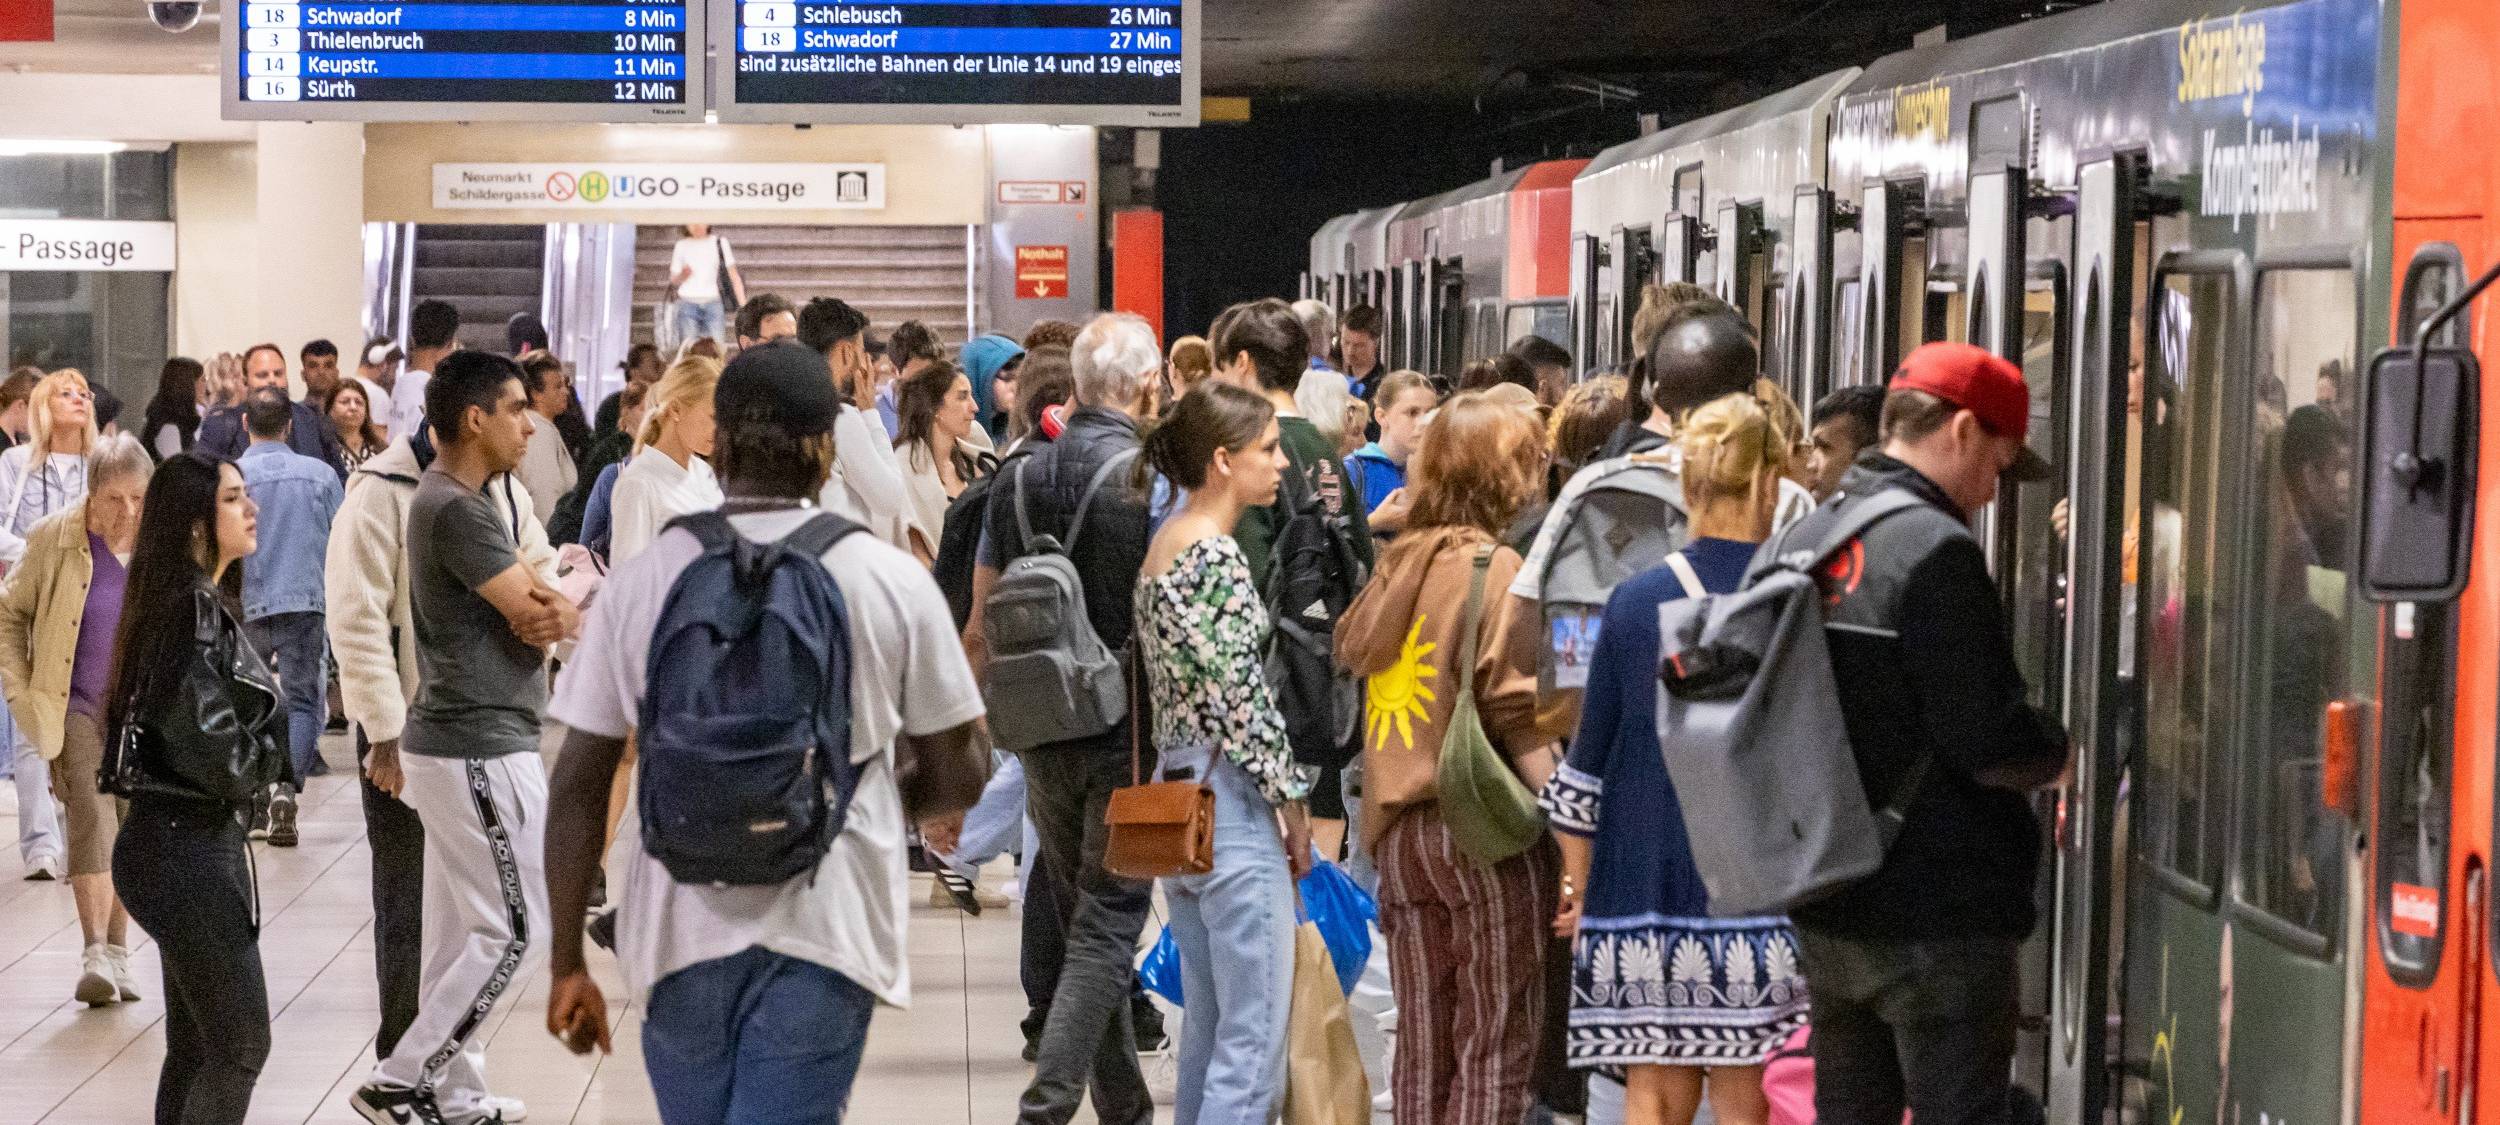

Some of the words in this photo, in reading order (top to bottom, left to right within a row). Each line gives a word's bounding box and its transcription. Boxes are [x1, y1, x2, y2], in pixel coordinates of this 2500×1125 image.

[266, 9, 284, 23] 18
[307, 7, 402, 25] Schwadorf
[624, 9, 637, 27] 8
[641, 9, 676, 27] Min
[765, 8, 775, 22] 4
[803, 6, 902, 24] Schlebusch
[1109, 7, 1132, 25] 26
[1137, 7, 1172, 25] Min
[269, 33, 279, 47] 3
[307, 31, 424, 50] Thielenbruch
[614, 33, 637, 52] 10
[641, 33, 676, 52] Min
[761, 32, 781, 46] 18
[803, 30, 899, 48] Schwadorf
[1109, 32, 1132, 50] 27
[1137, 32, 1172, 50] Min
[266, 57, 284, 71] 14
[307, 56, 379, 76] Keupstr.
[614, 58, 636, 76] 11
[641, 58, 676, 76] Min
[740, 54, 777, 72] sind
[780, 54, 877, 73] zusätzliche
[881, 54, 949, 73] Bahnen
[952, 54, 984, 73] der
[988, 55, 1029, 73] Linie
[1034, 55, 1057, 73] 14
[1060, 55, 1095, 74] und
[1100, 55, 1122, 74] 19
[1125, 55, 1182, 77] einges
[2178, 13, 2265, 118] Solaranlage
[266, 81, 285, 95] 16
[307, 79, 356, 98] Sürth
[614, 82, 637, 100] 12
[641, 82, 676, 100] Min
[462, 171, 532, 183] Neumarkt
[2201, 113, 2319, 234] Komplettpaket
[449, 187, 546, 202] Schildergasse
[701, 177, 806, 201] Passage
[19, 232, 134, 267] Passage
